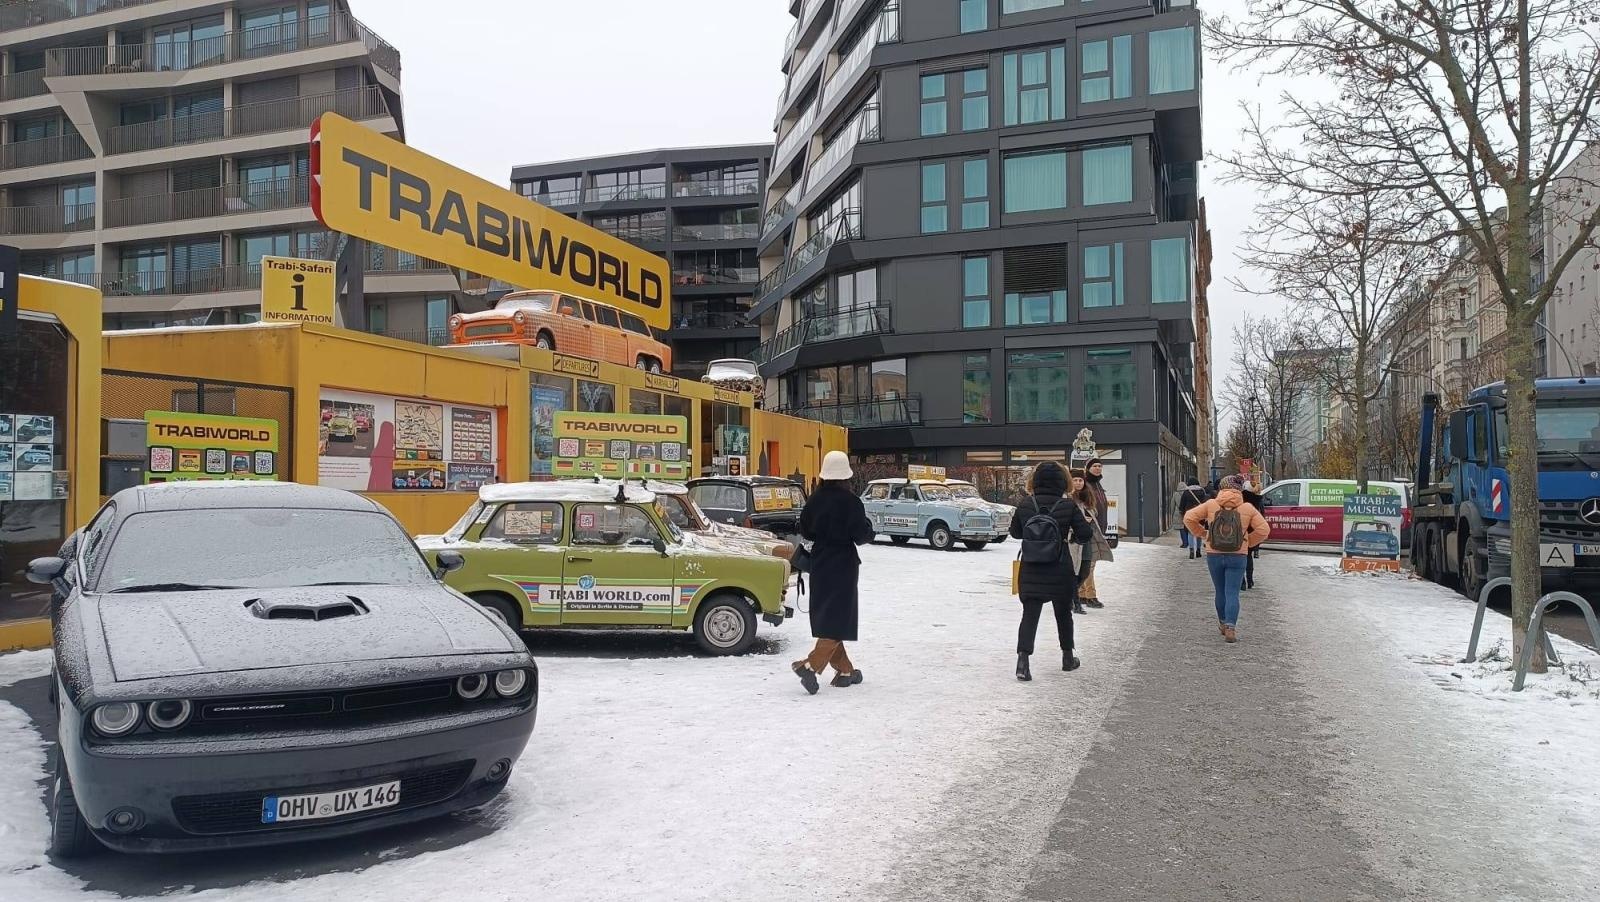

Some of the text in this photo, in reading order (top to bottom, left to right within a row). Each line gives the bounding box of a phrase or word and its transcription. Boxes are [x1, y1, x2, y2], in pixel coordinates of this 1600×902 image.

[342, 147, 662, 309] TRABIWORLD
[266, 260, 332, 274] Trabi-Safari
[265, 312, 332, 323] INFORMATION
[562, 358, 590, 373] DEPARTURES
[155, 424, 270, 441] TRABIWORLD
[563, 420, 678, 434] TRABIWORLD
[1354, 496, 1389, 505] TRABI-
[1347, 505, 1396, 515] MUSEUM
[1546, 546, 1566, 563] A
[548, 589, 671, 602] TRABI WORLD.com
[213, 704, 285, 712] CHALLENGER
[280, 797, 318, 818] OHV
[334, 792, 358, 812] UX
[362, 784, 397, 808] 146
